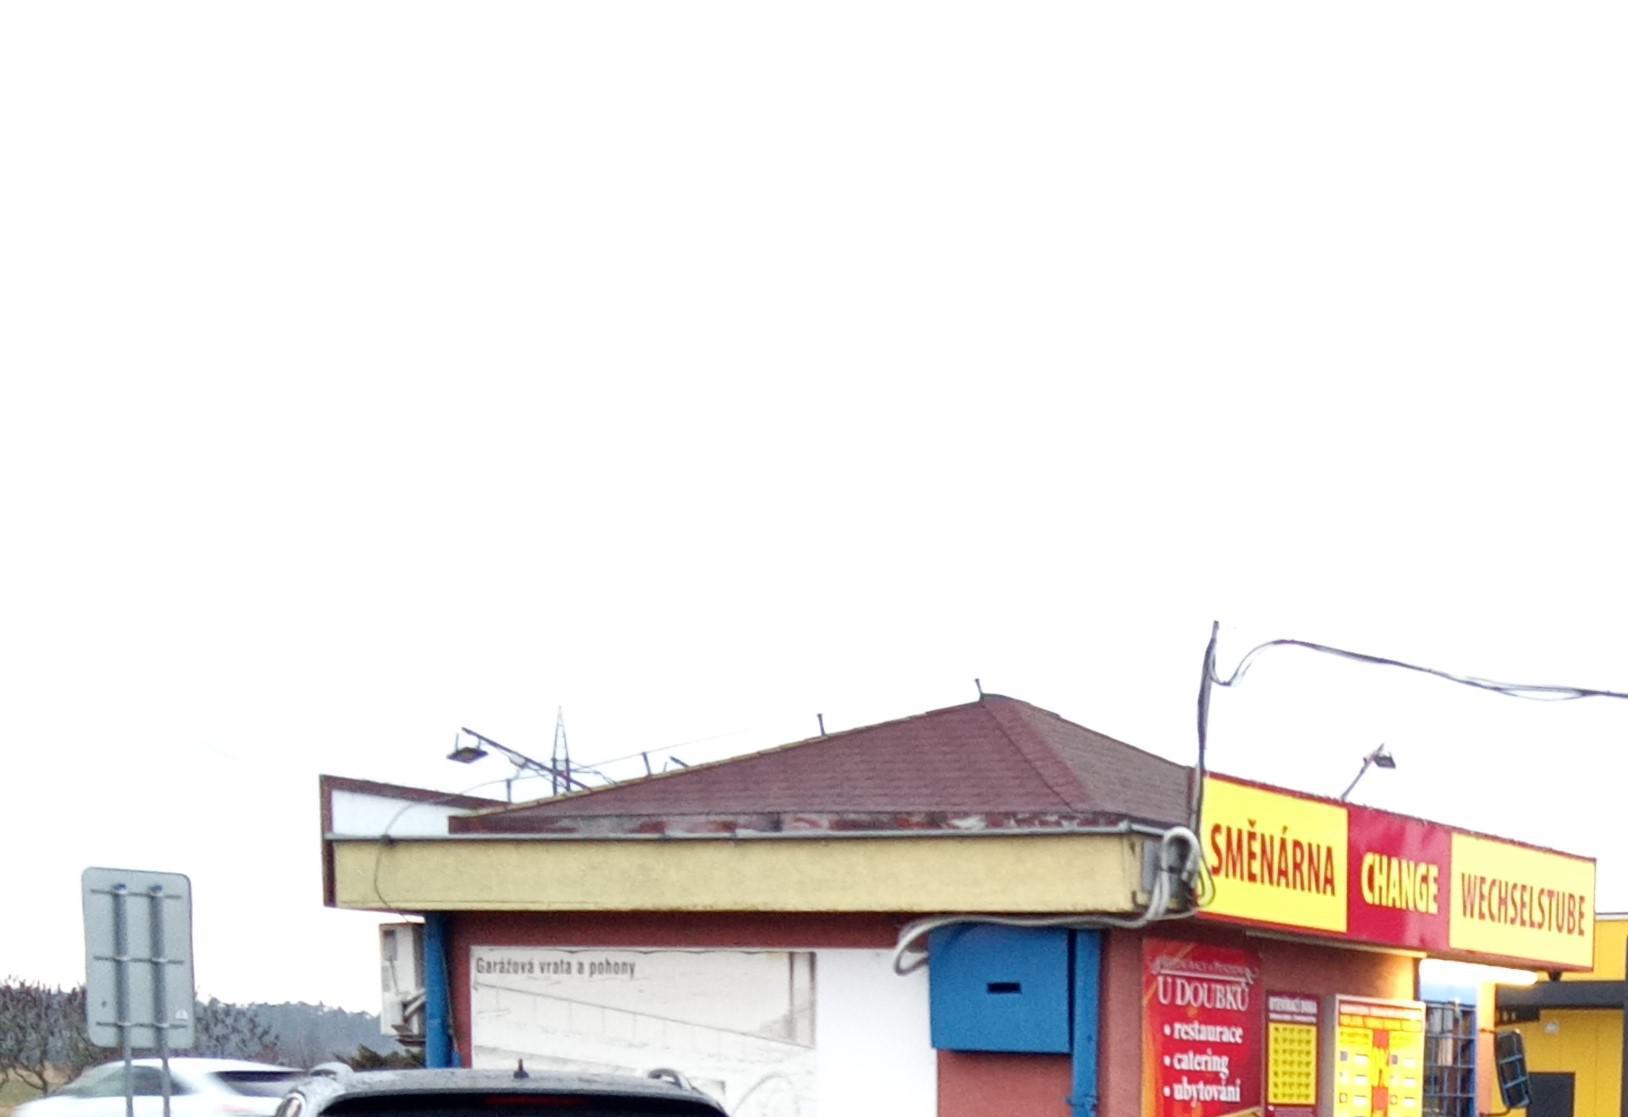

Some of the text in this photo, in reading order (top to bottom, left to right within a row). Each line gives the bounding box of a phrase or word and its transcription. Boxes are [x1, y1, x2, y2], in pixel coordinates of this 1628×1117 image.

[1211, 818, 1586, 936] SMĚNÁRNA CHANGE WECHSELSTUBE
[476, 957, 635, 979] Garážová vrata a pohony
[1157, 975, 1172, 1005] U
[1173, 1021, 1243, 1044] restaurace
[1173, 1048, 1229, 1079] catering
